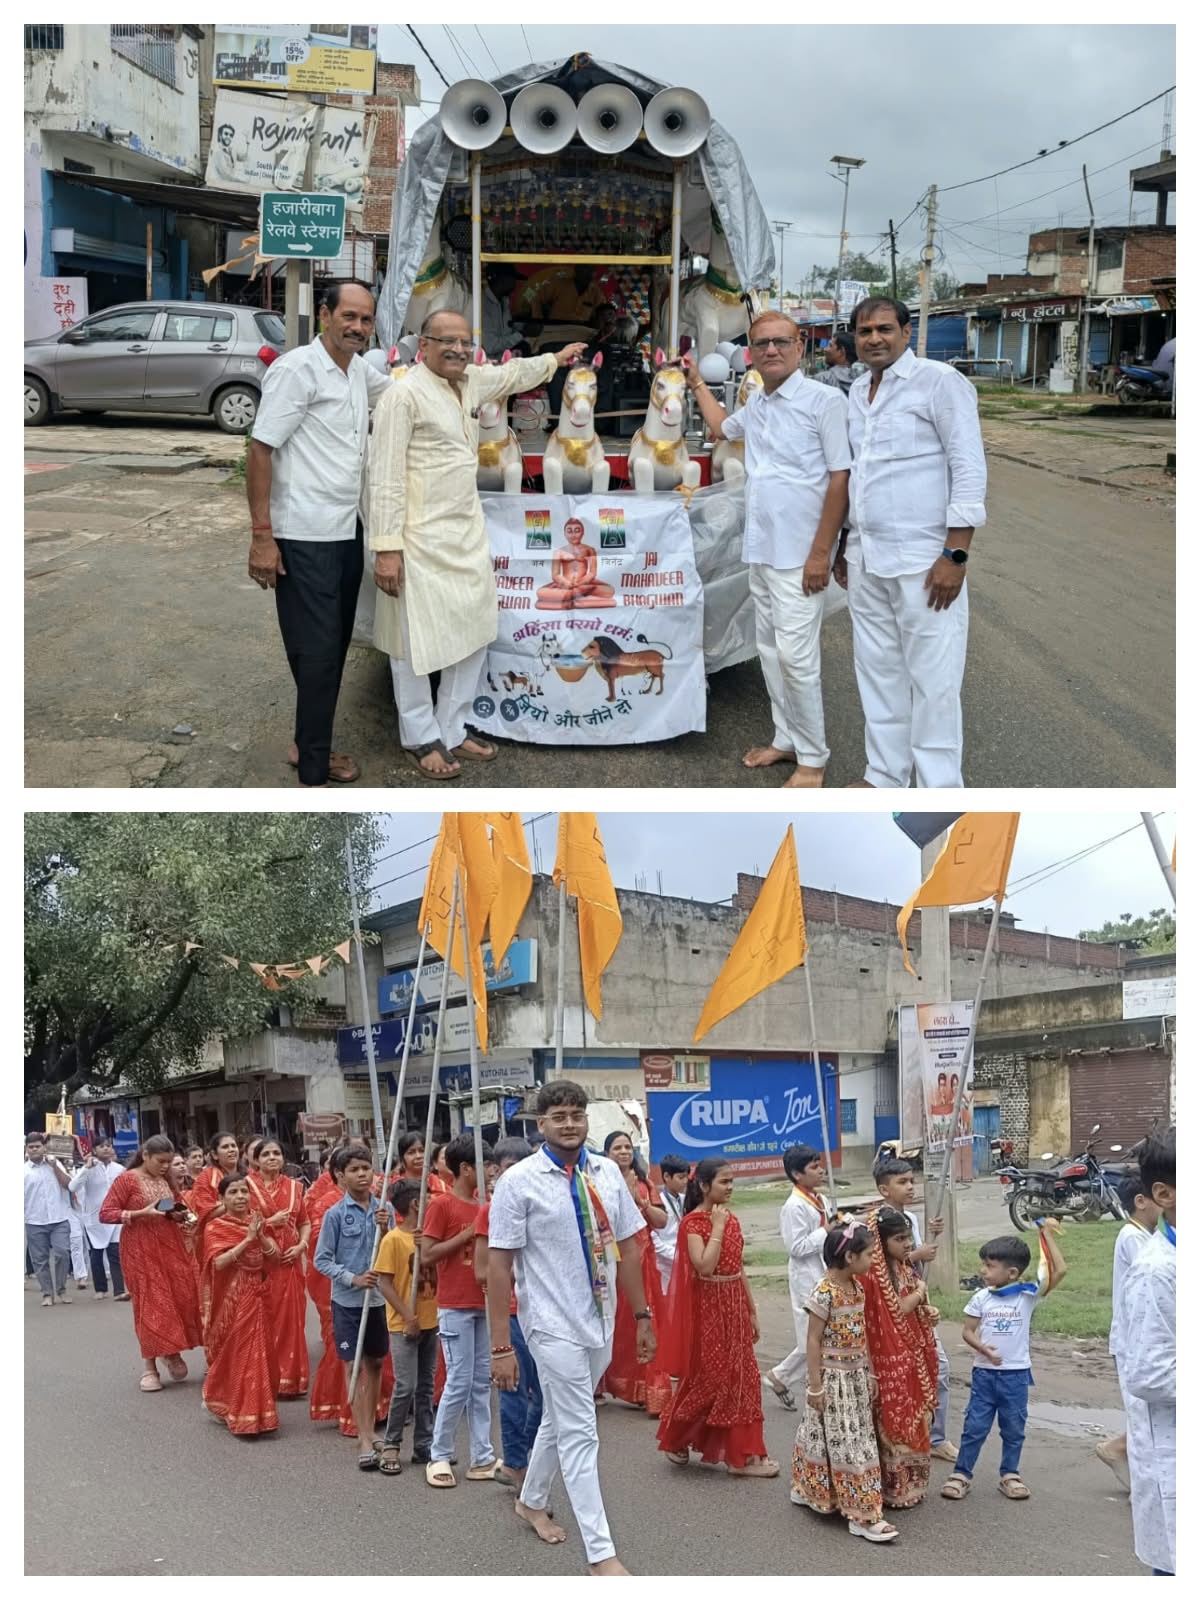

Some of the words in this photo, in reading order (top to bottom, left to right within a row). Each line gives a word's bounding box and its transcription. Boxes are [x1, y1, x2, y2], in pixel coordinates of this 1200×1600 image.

[285, 46, 304, 55] 15%
[272, 198, 336, 216] हजारीबाग
[265, 219, 296, 238] रेलवे
[300, 220, 341, 239] स्टेशन
[53, 300, 76, 314] दही
[493, 556, 510, 571] JAI
[642, 552, 658, 570] JAI
[495, 576, 534, 590] AVEER
[621, 571, 684, 588] MAHAVEER
[513, 619, 561, 642] अहिंसा
[565, 617, 602, 631] परमो
[554, 710, 581, 728] और
[583, 706, 613, 725] जीने
[614, 699, 632, 714] दो
[691, 1099, 769, 1127] RUPA
[773, 1087, 821, 1135] Jon
